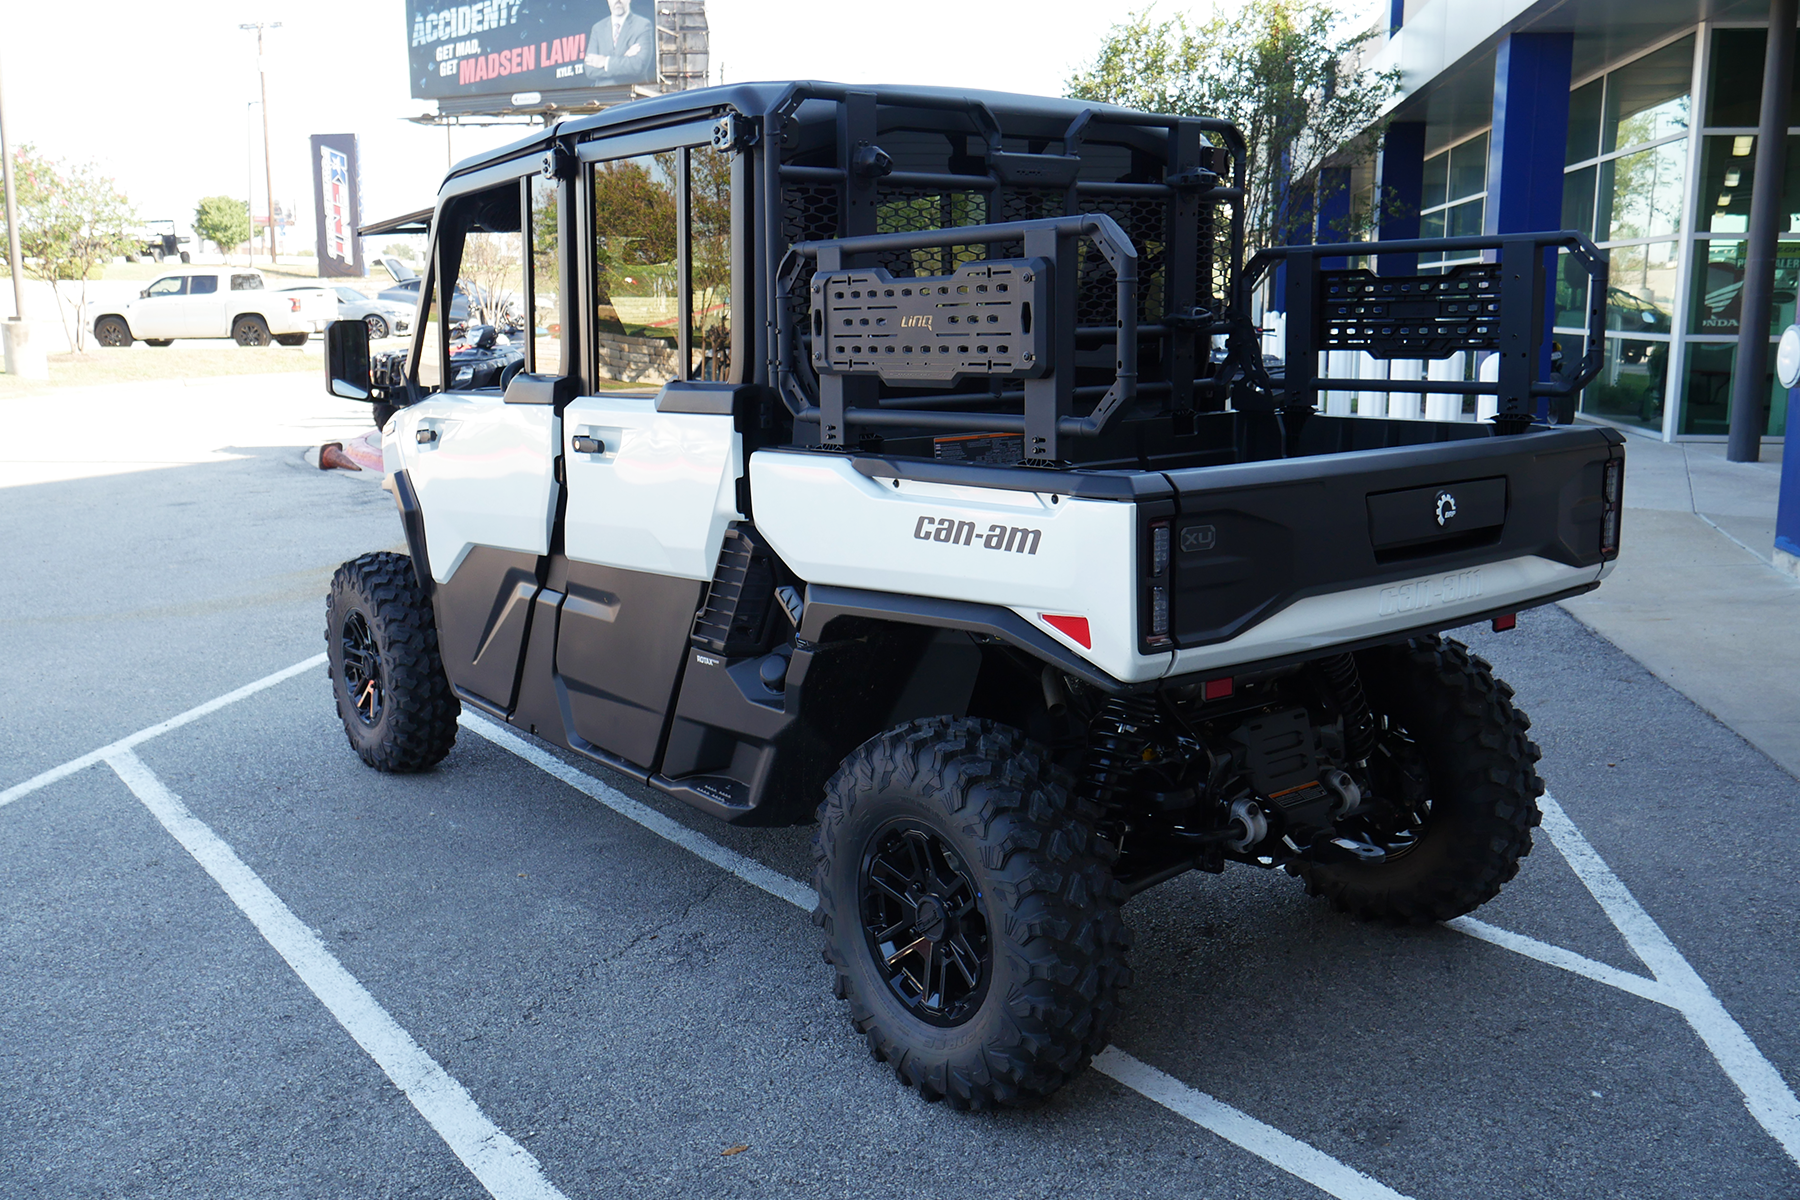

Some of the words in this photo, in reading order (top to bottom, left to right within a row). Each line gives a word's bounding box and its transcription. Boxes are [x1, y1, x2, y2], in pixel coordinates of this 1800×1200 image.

[412, 0, 521, 47] ACCIDENT?
[436, 44, 454, 61] GET
[455, 39, 481, 57] MAD,
[440, 59, 458, 77] GET
[459, 45, 536, 85] MADSEN
[540, 33, 586, 68] LAW!
[556, 65, 574, 79] KYLE,
[575, 63, 584, 74] TX
[329, 151, 354, 266] KENT
[914, 516, 1042, 555] can-am
[1379, 569, 1483, 617] can-am
